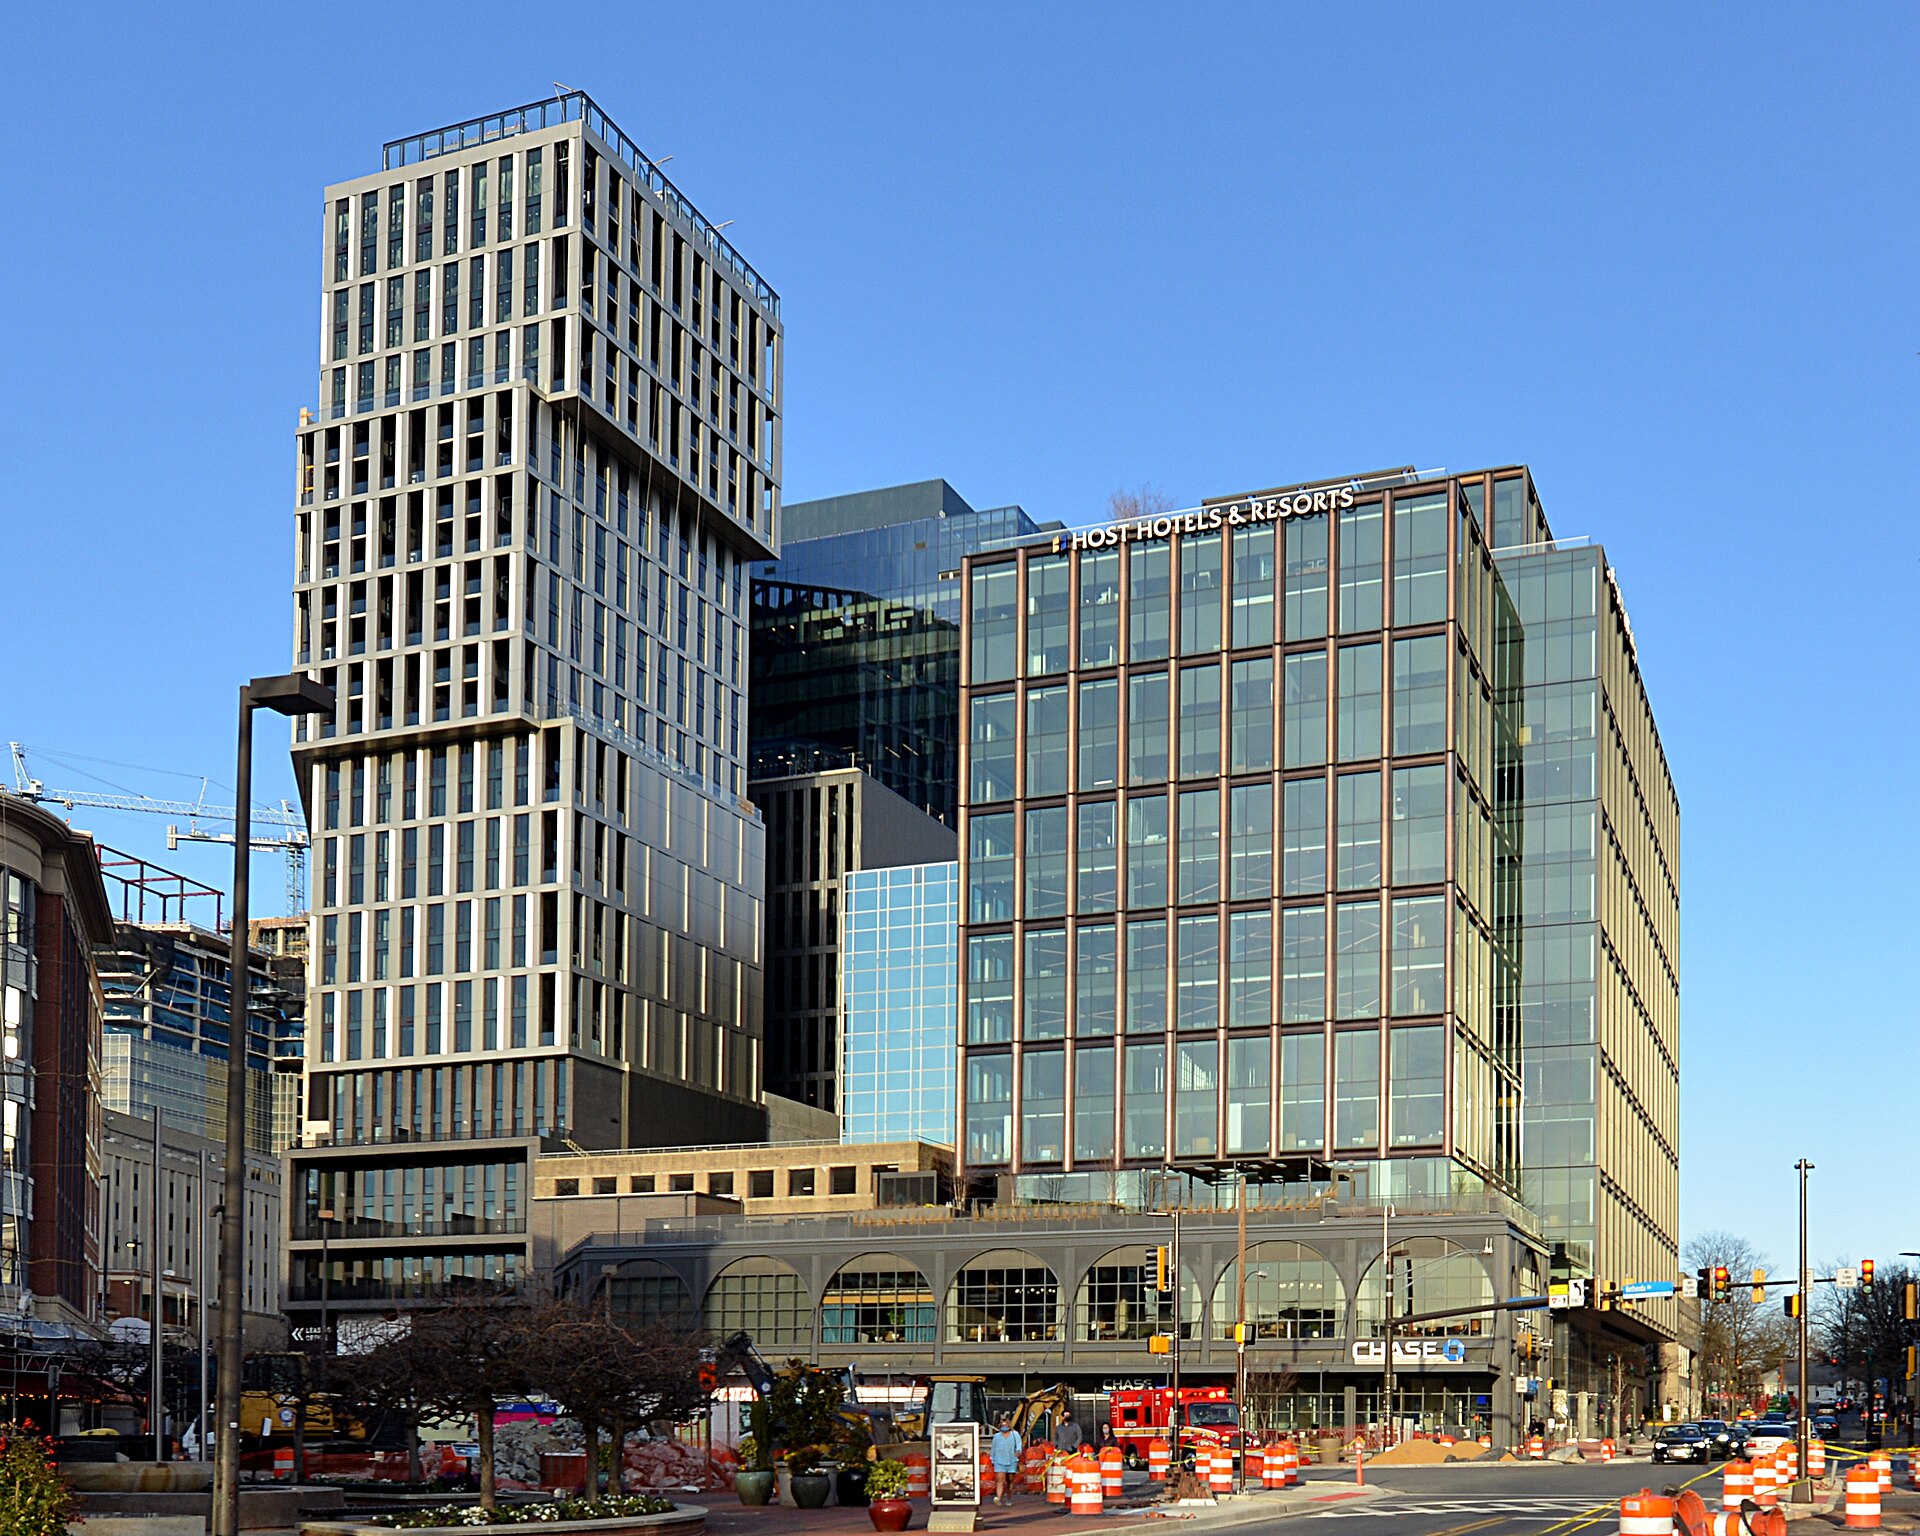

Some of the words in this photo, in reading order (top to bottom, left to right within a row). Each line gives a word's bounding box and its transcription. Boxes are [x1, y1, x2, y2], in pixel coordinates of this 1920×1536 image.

[1072, 524, 1129, 550] HOST
[1137, 509, 1221, 540] HOTELS
[1228, 505, 1246, 525] &
[1250, 487, 1354, 521] RESORTS
[1352, 1341, 1437, 1360] CHASE
[1103, 1379, 1153, 1390] CHASE
